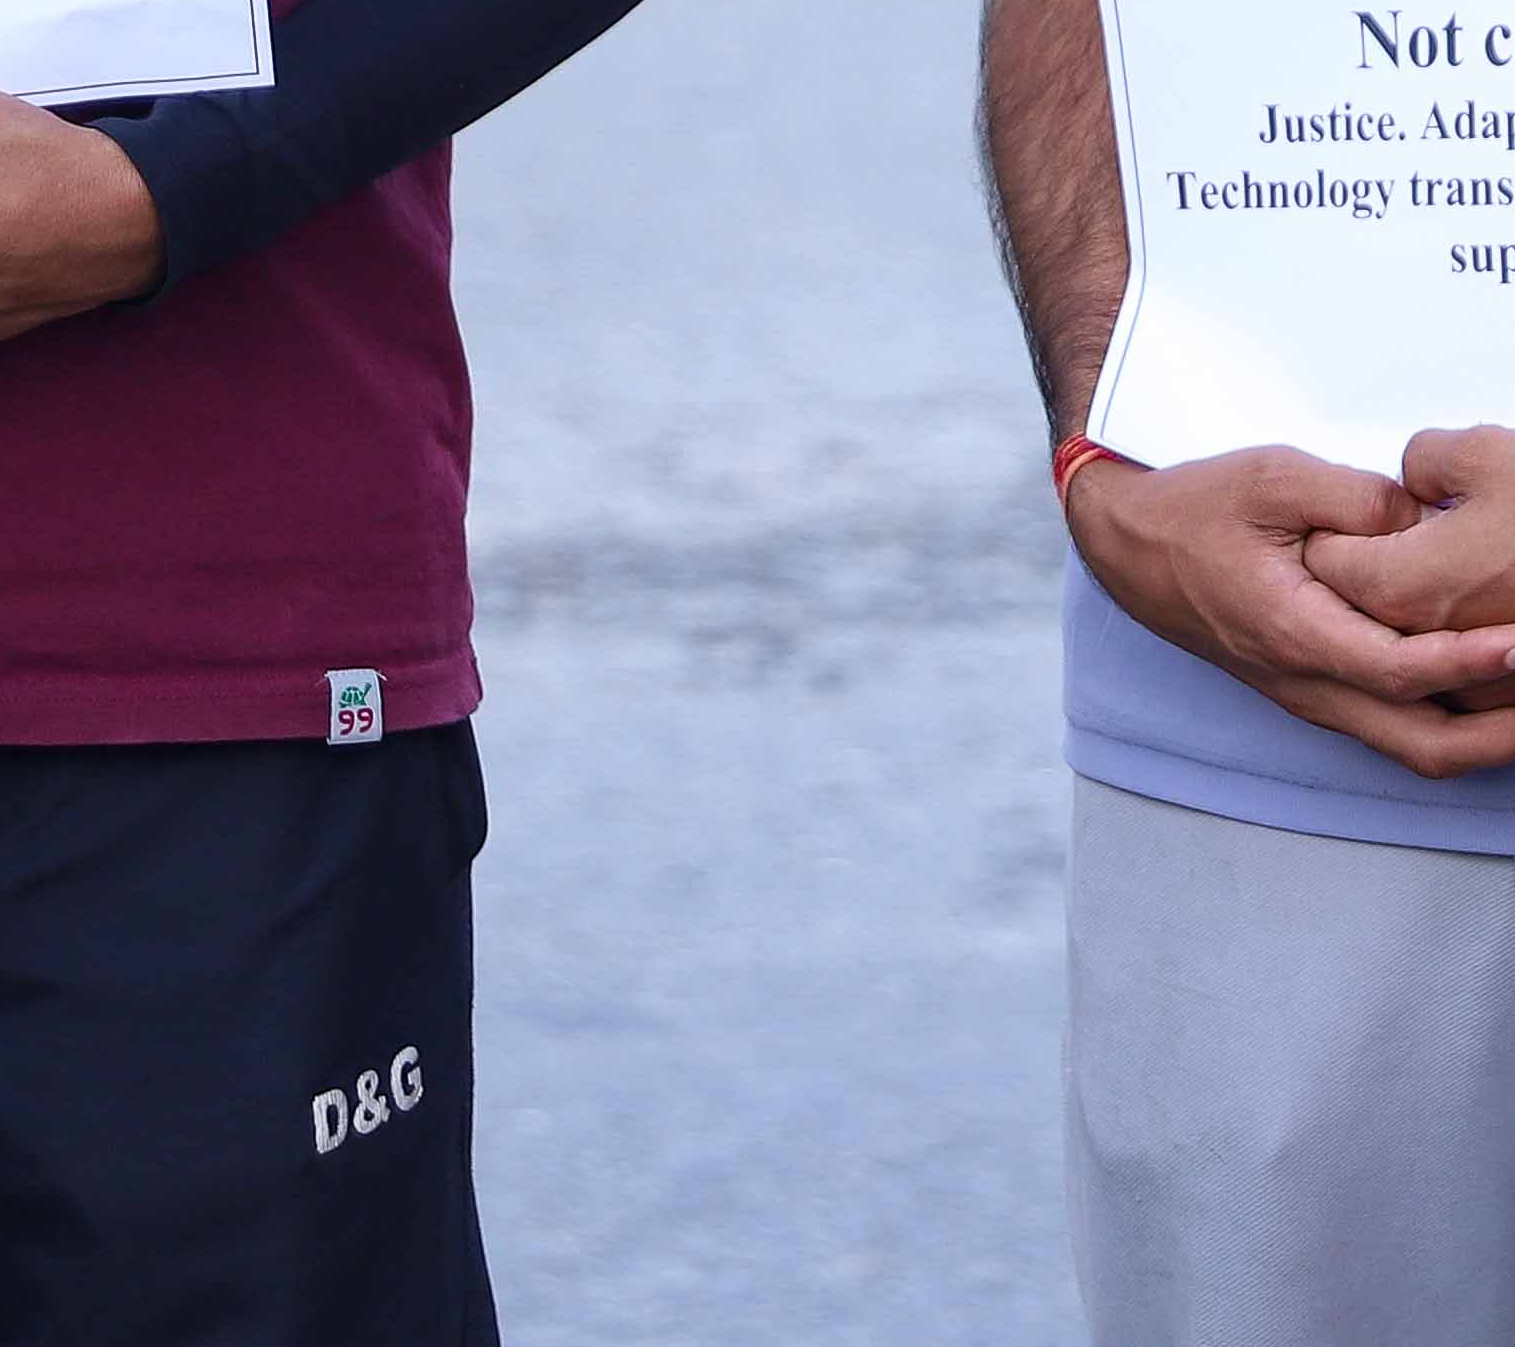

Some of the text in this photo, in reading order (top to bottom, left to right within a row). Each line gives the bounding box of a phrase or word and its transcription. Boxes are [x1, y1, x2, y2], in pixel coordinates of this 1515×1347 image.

[1353, 8, 1464, 71] Not
[1258, 100, 1408, 146] Justice.
[1166, 166, 1396, 219] Technology
[338, 708, 374, 736] 99
[312, 1045, 424, 1154] D&G
